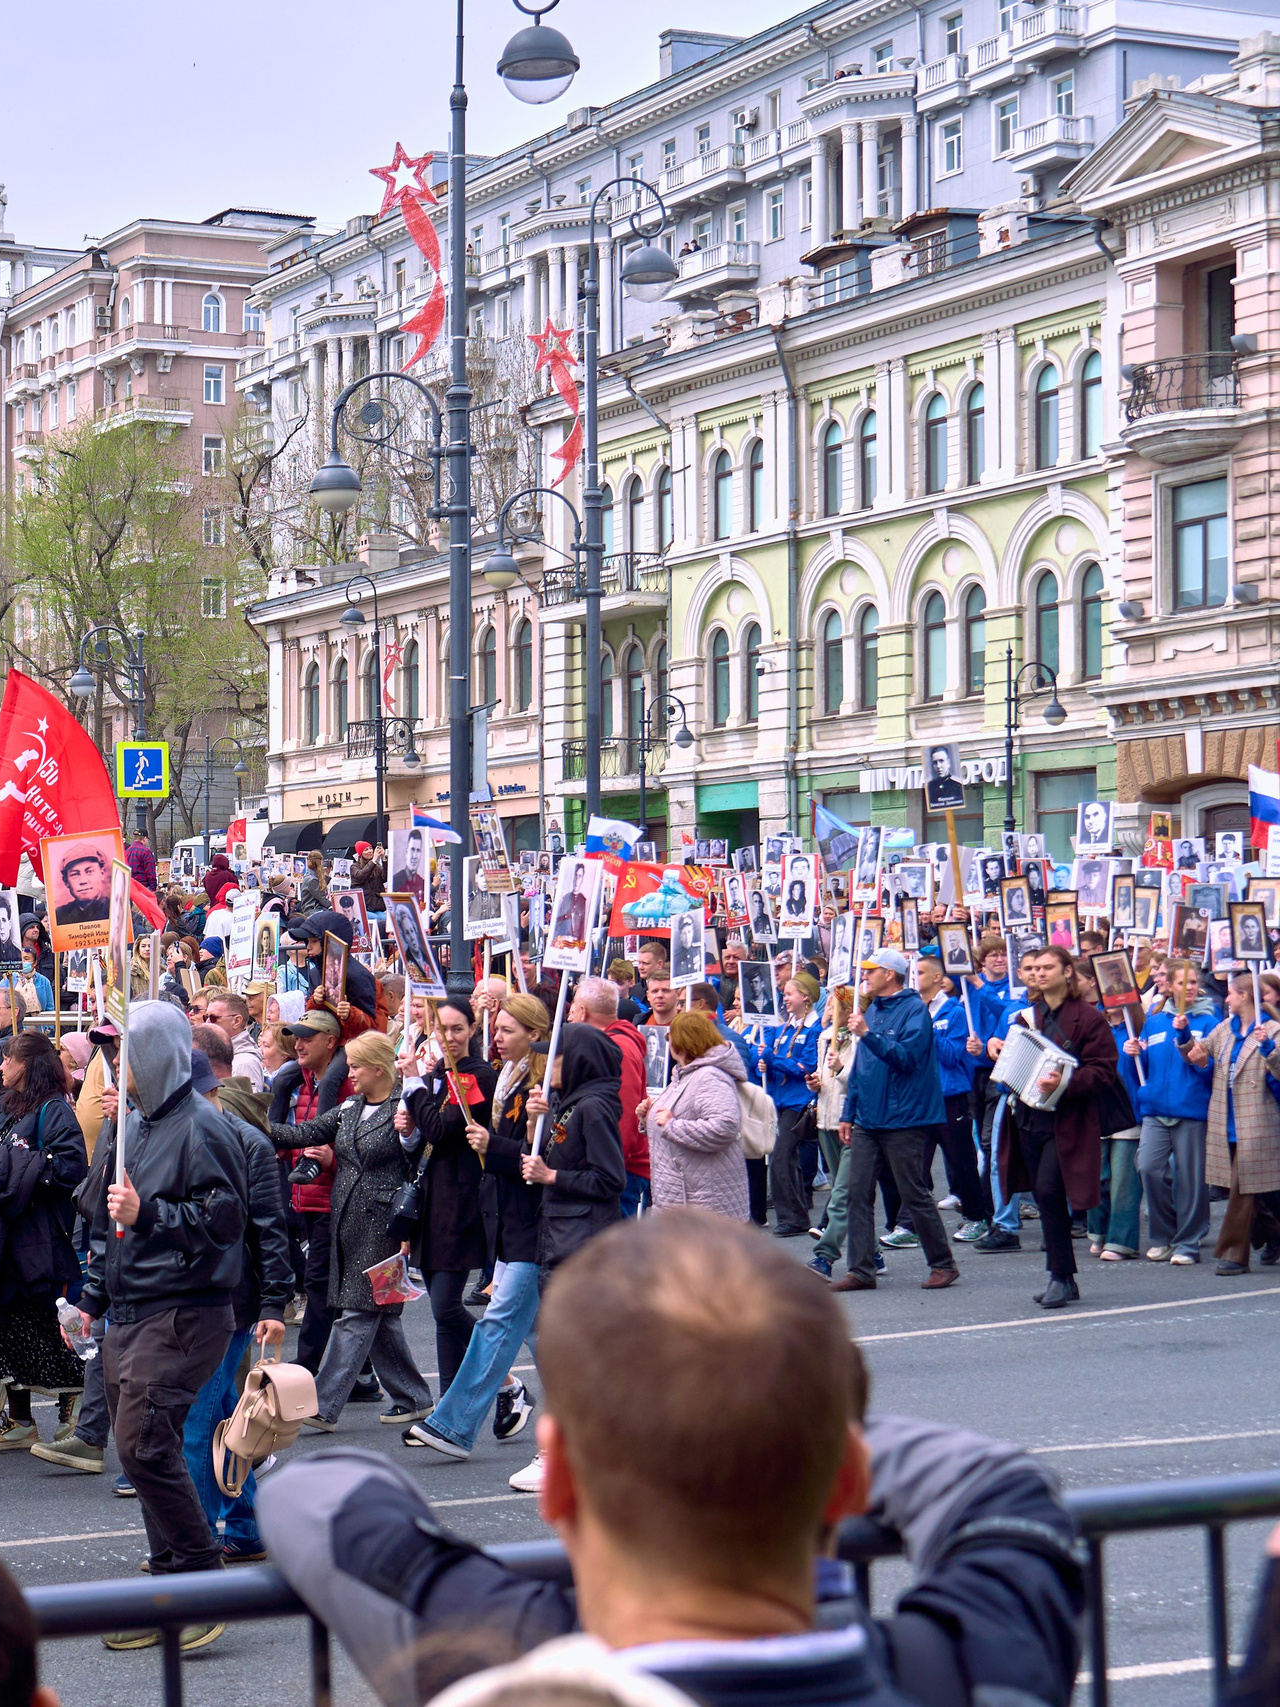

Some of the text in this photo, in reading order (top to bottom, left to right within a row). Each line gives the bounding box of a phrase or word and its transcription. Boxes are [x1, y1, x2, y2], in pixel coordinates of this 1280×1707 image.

[637, 918, 672, 928] НА БЕ
[68, 931, 95, 940] Тимофей
[75, 938, 109, 947] 1923-1943
